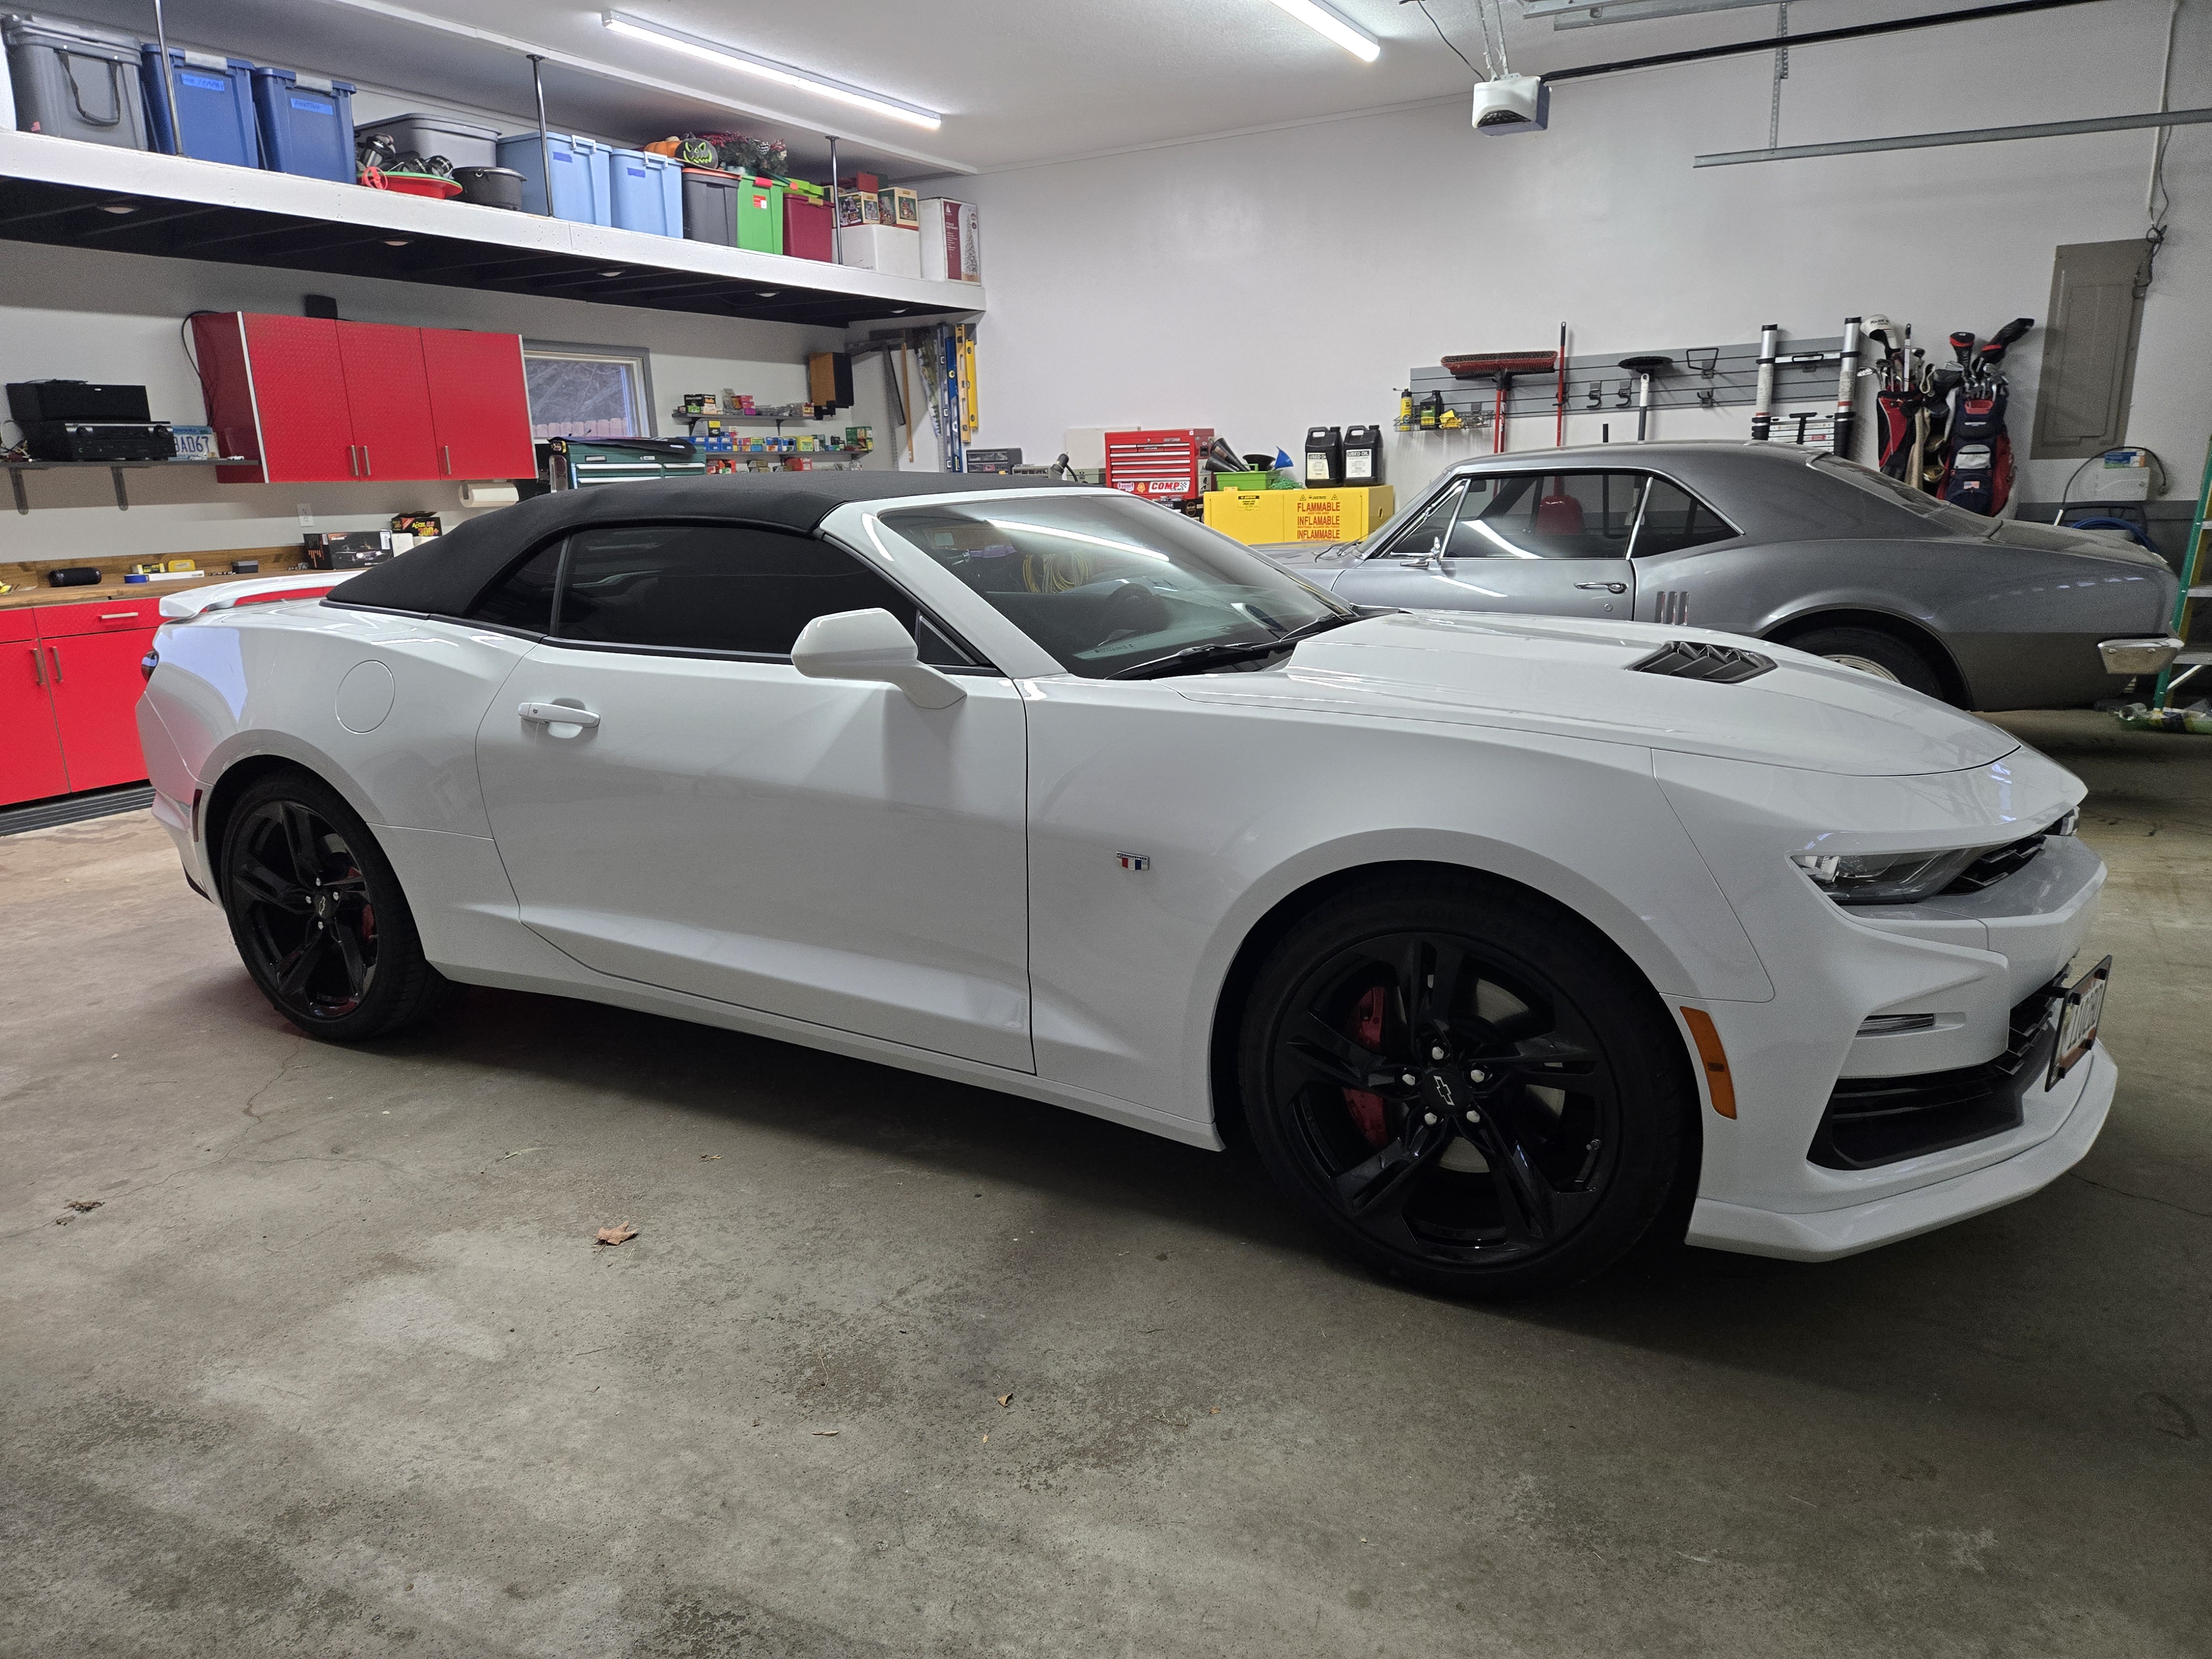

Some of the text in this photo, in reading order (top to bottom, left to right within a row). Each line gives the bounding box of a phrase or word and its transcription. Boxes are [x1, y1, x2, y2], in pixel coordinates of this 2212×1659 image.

[1297, 502, 1340, 512] FLAMMABLE
[1297, 515, 1340, 525] INFLAMABLE
[418, 526, 439, 536] 300+
[1297, 529, 1340, 539] INFLAMMABLE
